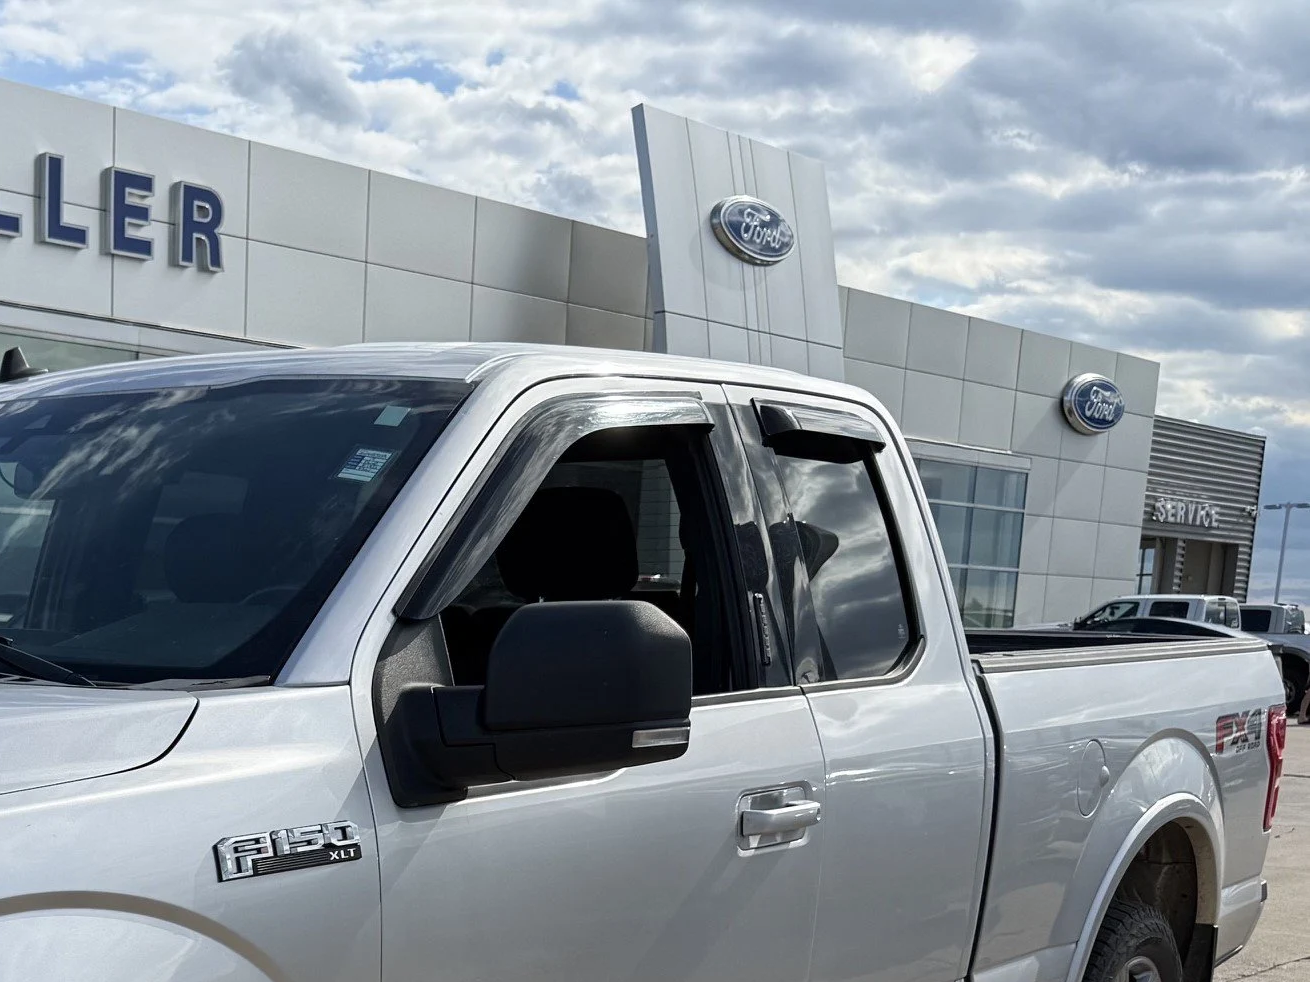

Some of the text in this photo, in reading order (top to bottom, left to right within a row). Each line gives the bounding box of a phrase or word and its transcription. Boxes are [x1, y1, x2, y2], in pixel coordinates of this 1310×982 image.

[741, 207, 782, 249] Ford
[1085, 386, 1117, 421] Ford
[1153, 498, 1221, 527] SERVICE
[1215, 708, 1261, 753] FX4
[329, 848, 356, 861] XLT
